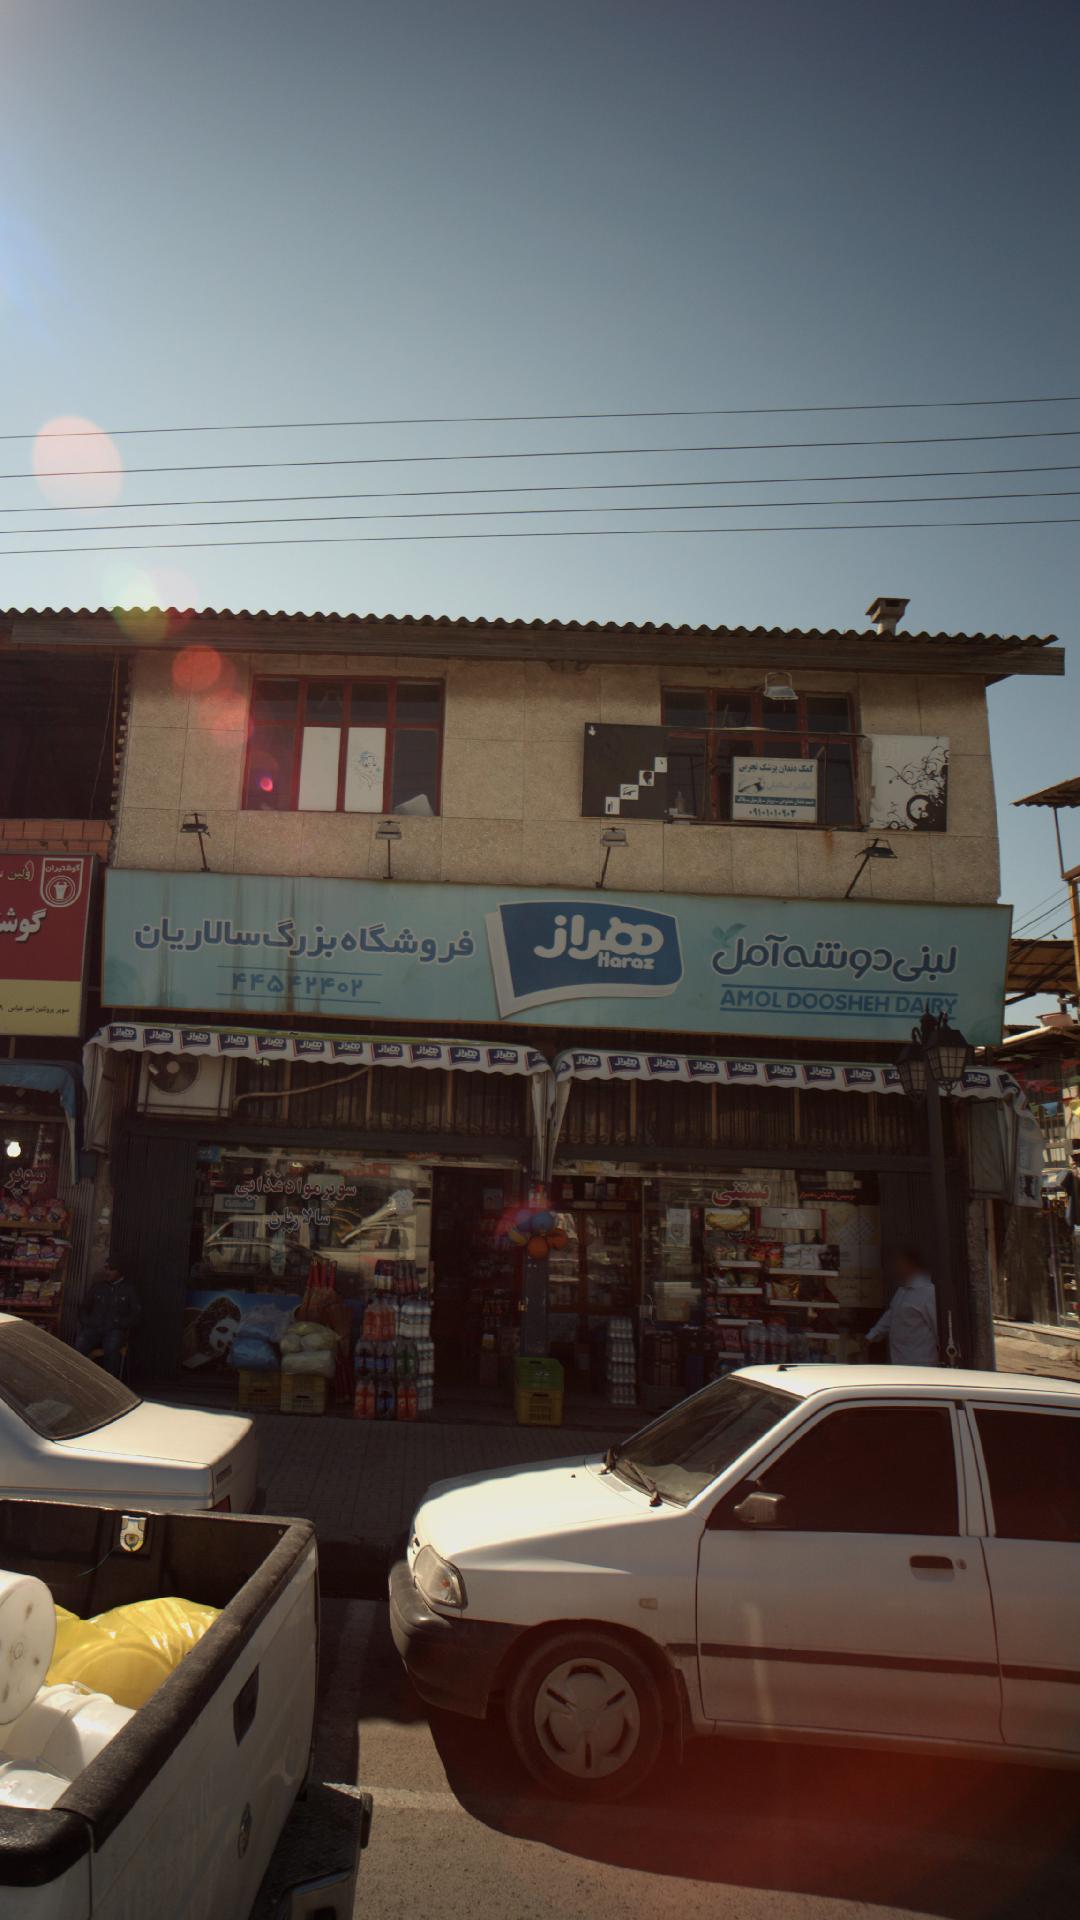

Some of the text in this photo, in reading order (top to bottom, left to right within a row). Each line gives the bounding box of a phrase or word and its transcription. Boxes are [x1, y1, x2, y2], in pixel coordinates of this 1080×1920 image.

[134, 918, 475, 963] فروشگاه بزرگ سالاریان
[534, 914, 664, 960] هراز
[712, 934, 957, 982] لبنی دوشه آمل
[598, 951, 655, 970] Haraz
[720, 989, 957, 1015] AMOL DOOSHEH DAIRY
